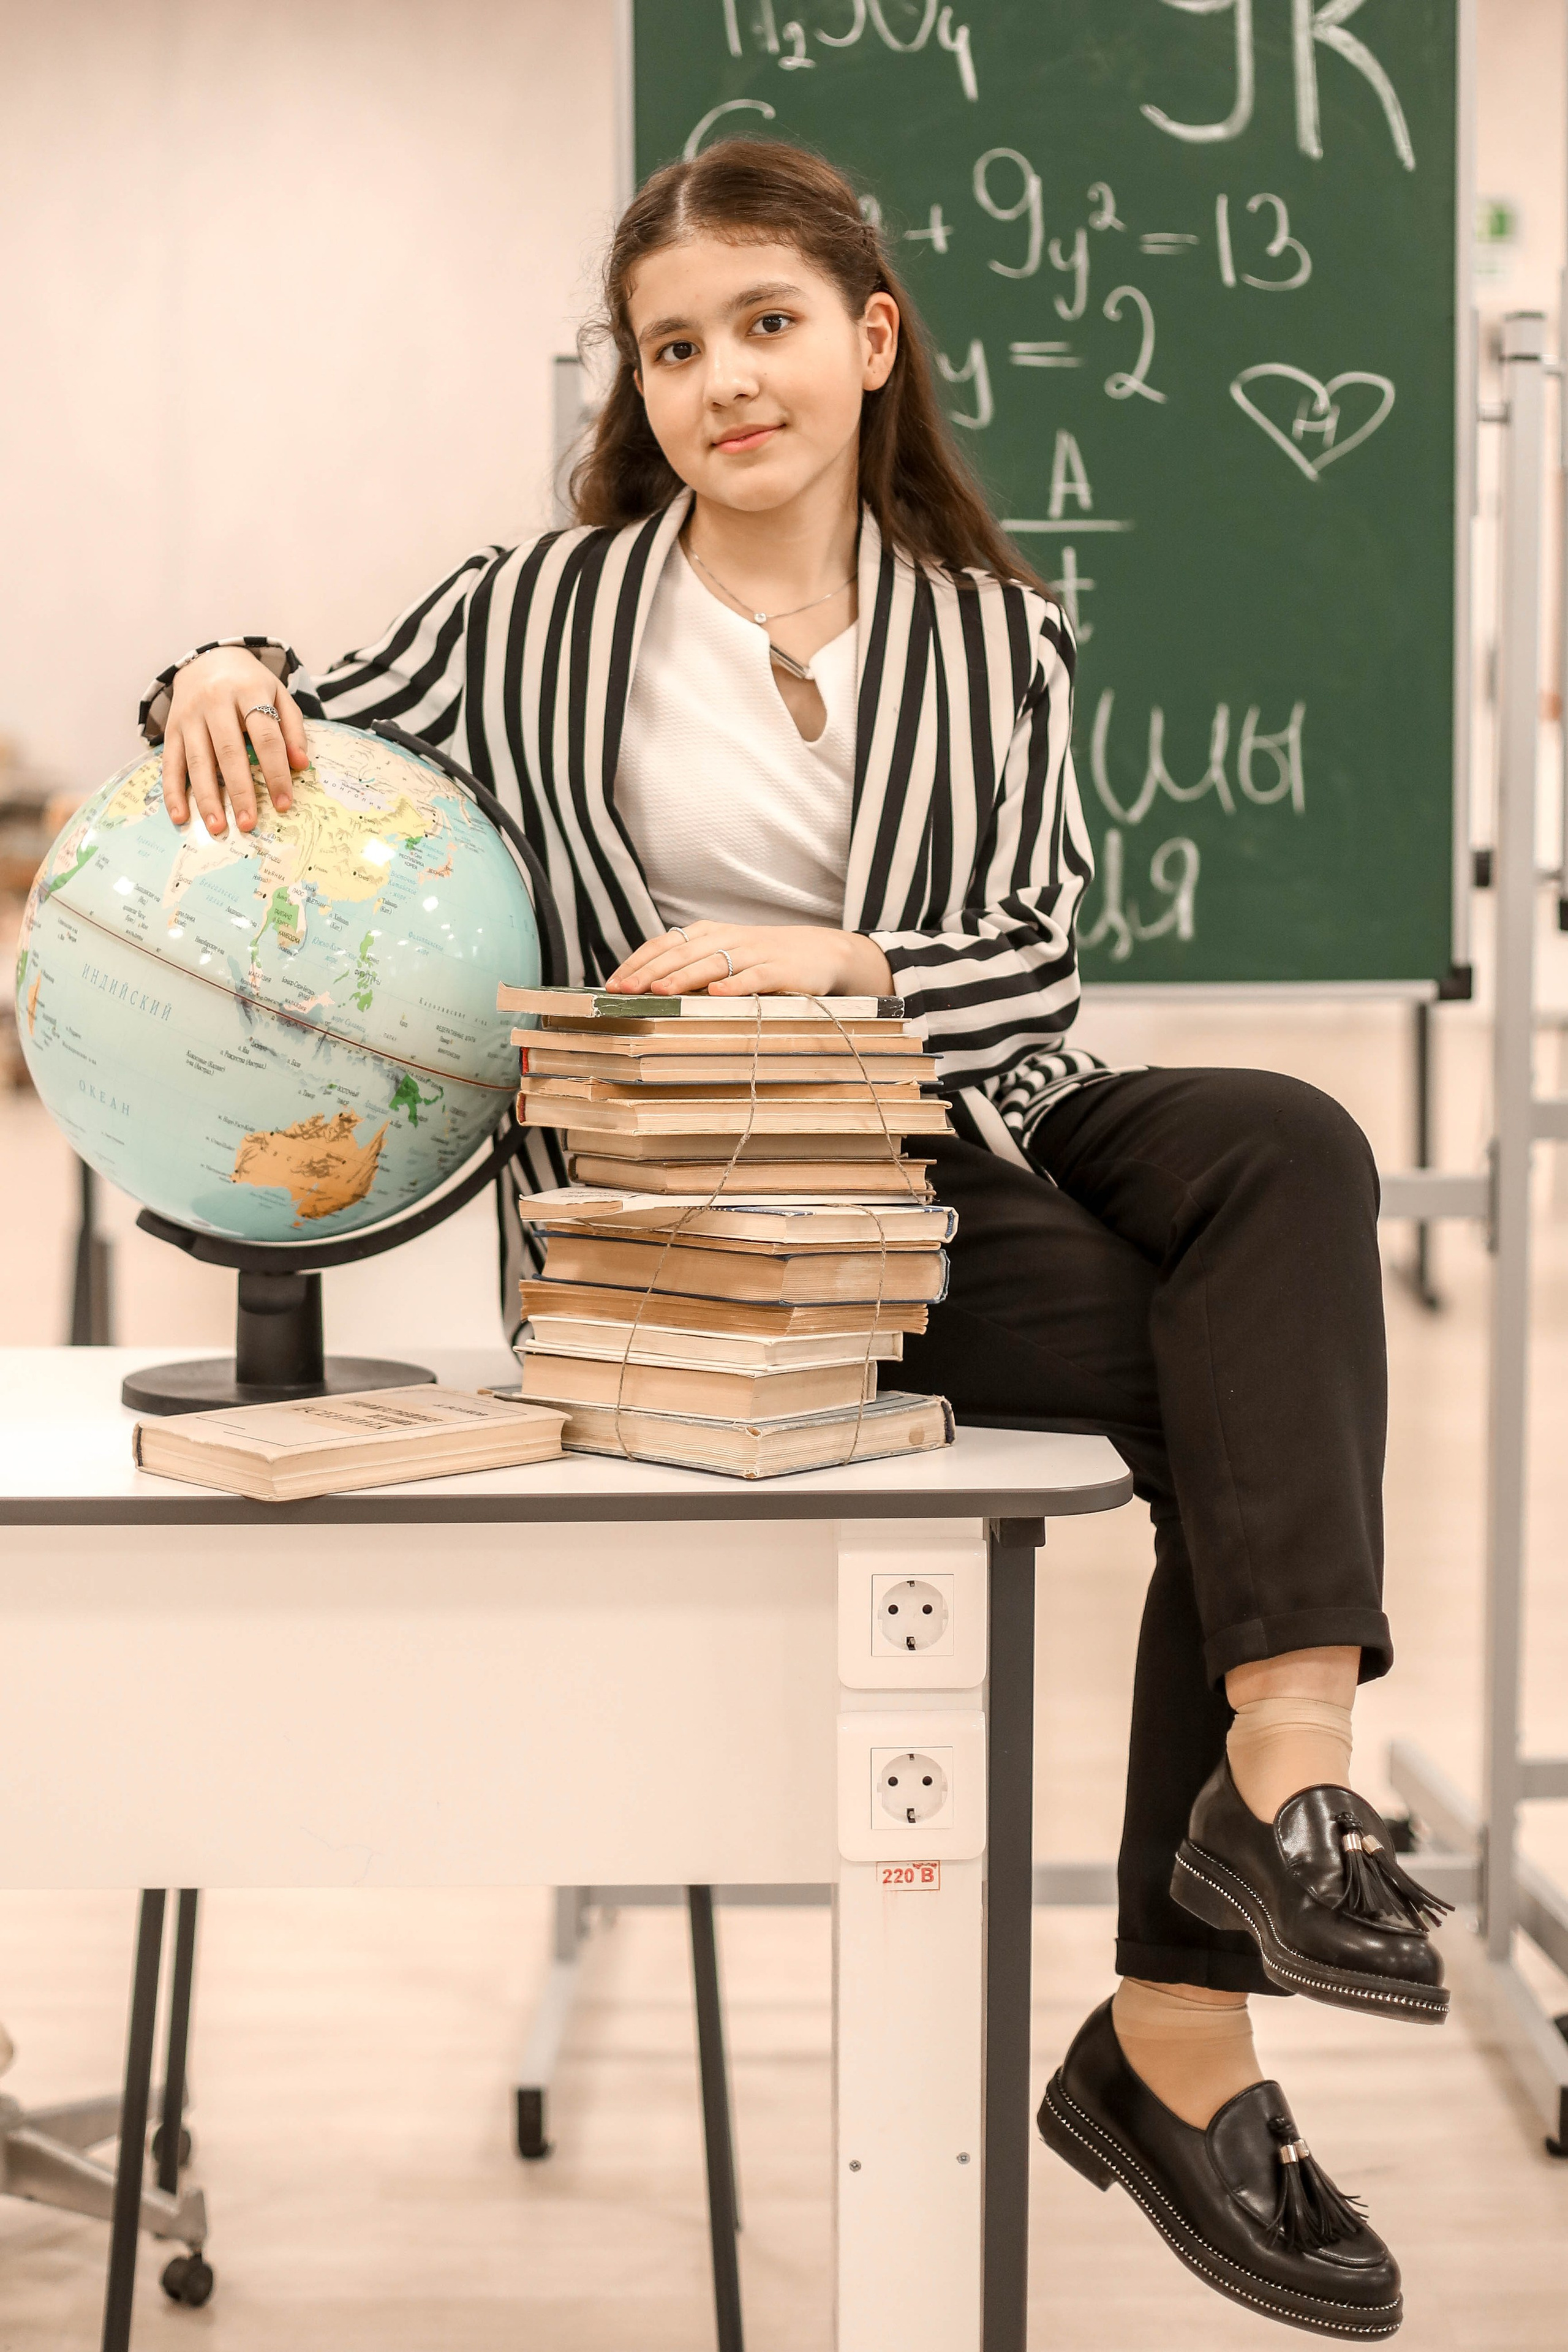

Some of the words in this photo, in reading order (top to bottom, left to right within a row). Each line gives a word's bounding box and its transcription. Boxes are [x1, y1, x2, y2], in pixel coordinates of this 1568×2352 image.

[1215, 192, 1313, 292] 13
[1104, 285, 1167, 405] 2
[264, 869, 285, 881] МЬЯНМА
[292, 888, 304, 897] ЛАОС
[81, 962, 173, 1021] ИНДИЙСКИЙ
[78, 1080, 131, 1117] ОКЕАН
[293, 1406, 391, 1430] ЕСЕНИНА
[883, 1868, 914, 1884] 220
